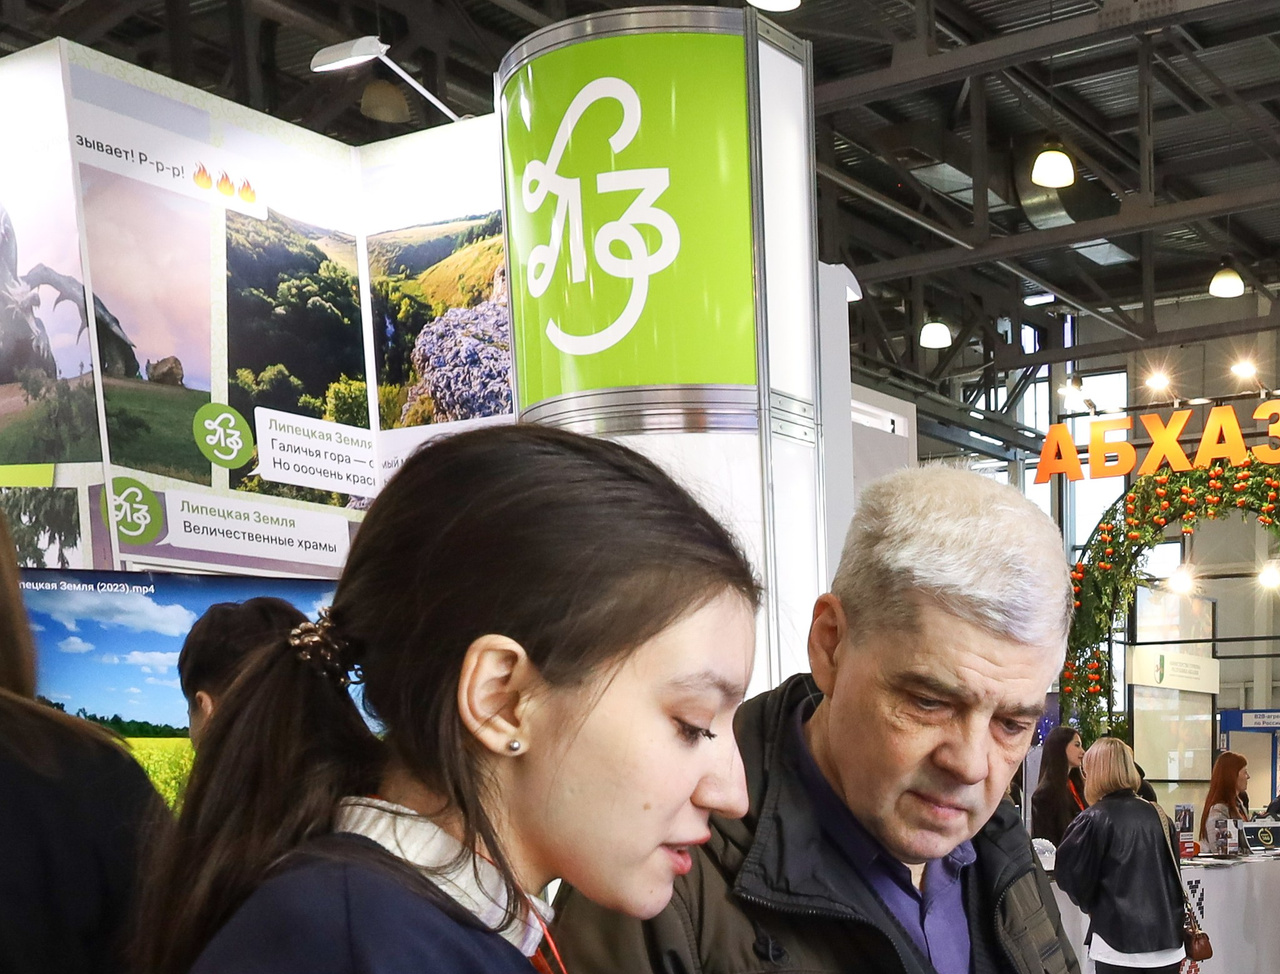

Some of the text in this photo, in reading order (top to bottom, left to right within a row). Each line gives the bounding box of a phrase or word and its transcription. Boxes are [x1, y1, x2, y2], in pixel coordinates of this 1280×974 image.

[139, 152, 185, 178] Р-р-р!
[268, 419, 372, 449] Липецкая Земля
[271, 438, 321, 458] Галичья
[324, 451, 351, 464] гора
[273, 457, 290, 471] Но
[293, 464, 343, 481] ооочень
[180, 500, 296, 528] Липецкая Земля
[183, 521, 337, 553] Величественные храмы
[60, 582, 94, 591] Земля
[97, 581, 155, 594] (2023).mp4
